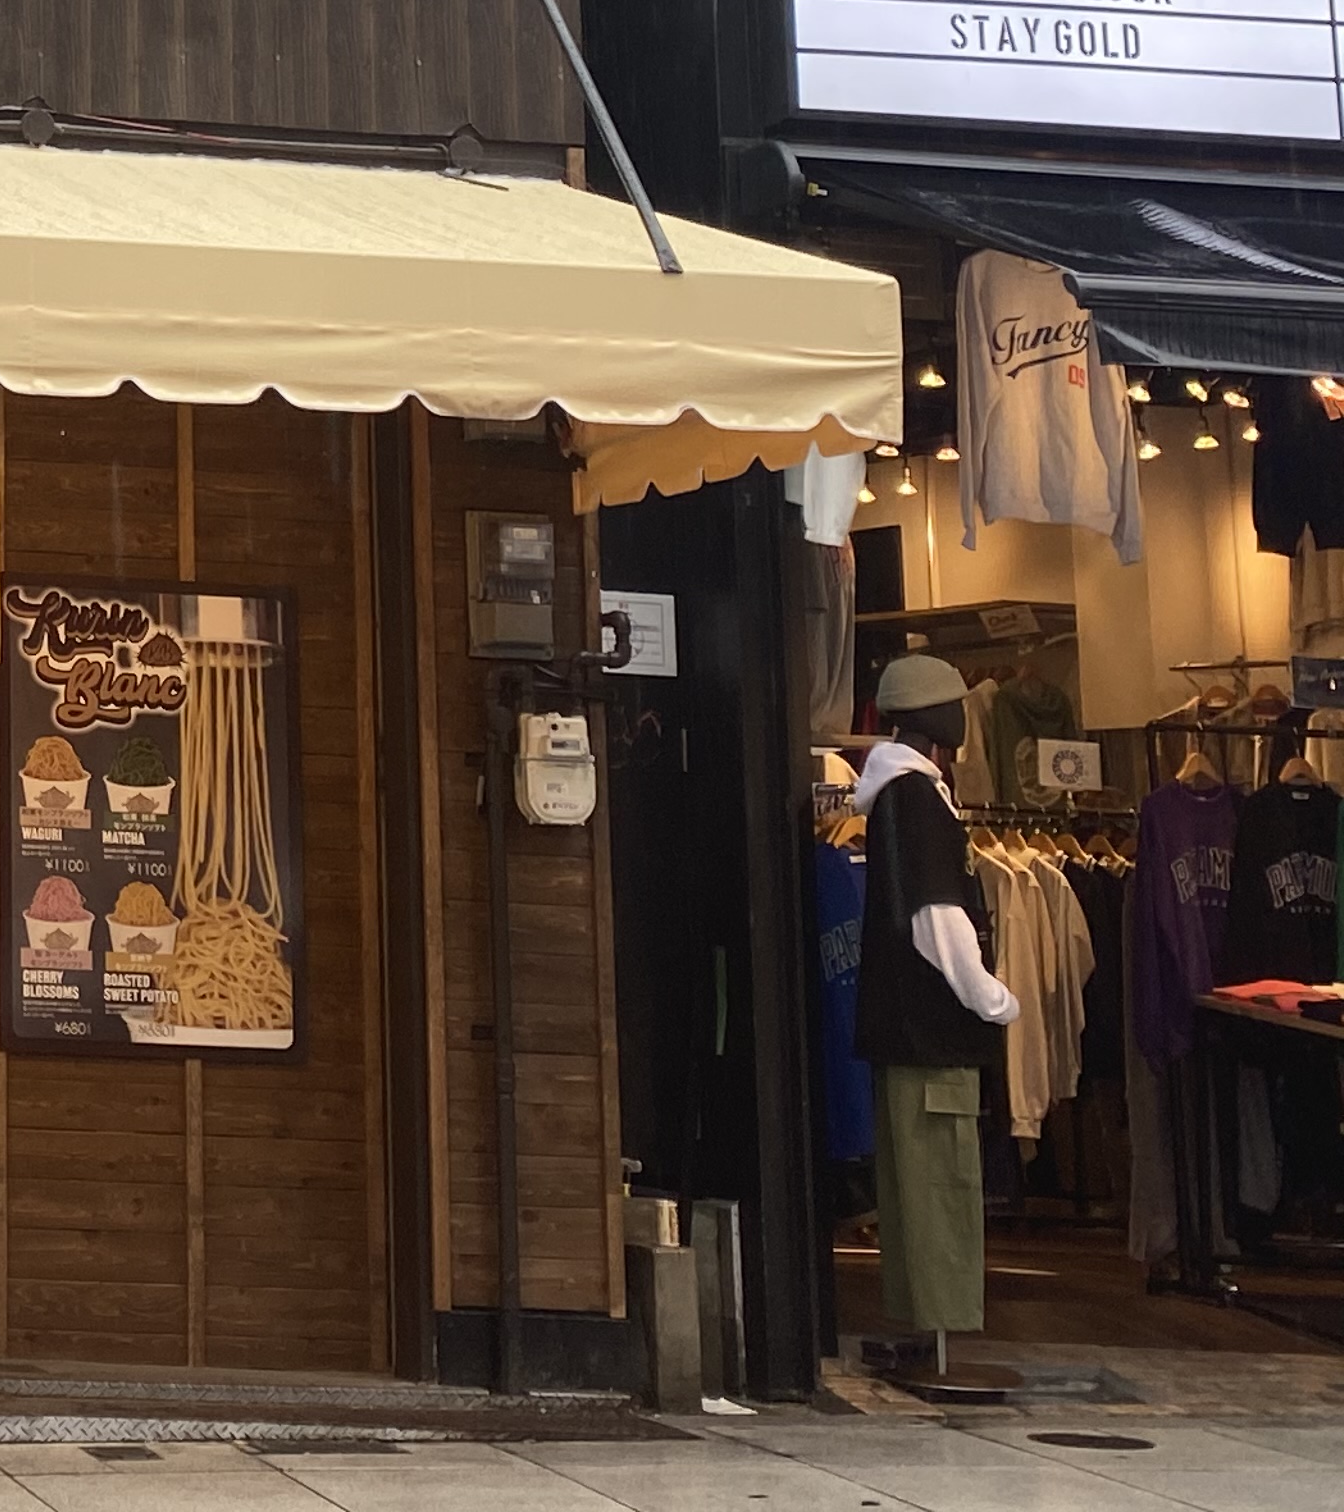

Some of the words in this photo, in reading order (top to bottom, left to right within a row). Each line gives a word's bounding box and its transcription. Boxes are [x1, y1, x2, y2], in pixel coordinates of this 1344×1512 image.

[992, 315, 1091, 366] Fancy
[6, 588, 150, 663] Kurin
[35, 656, 187, 728] Blanc
[21, 826, 63, 842] WAGURI
[102, 830, 146, 846] MATCHA
[23, 969, 64, 984] CHERRY
[103, 973, 151, 988] ROASTED
[23, 984, 80, 1000] BLOSSOMS
[103, 988, 140, 1001] SWEET
[140, 990, 179, 1004] POTATO
